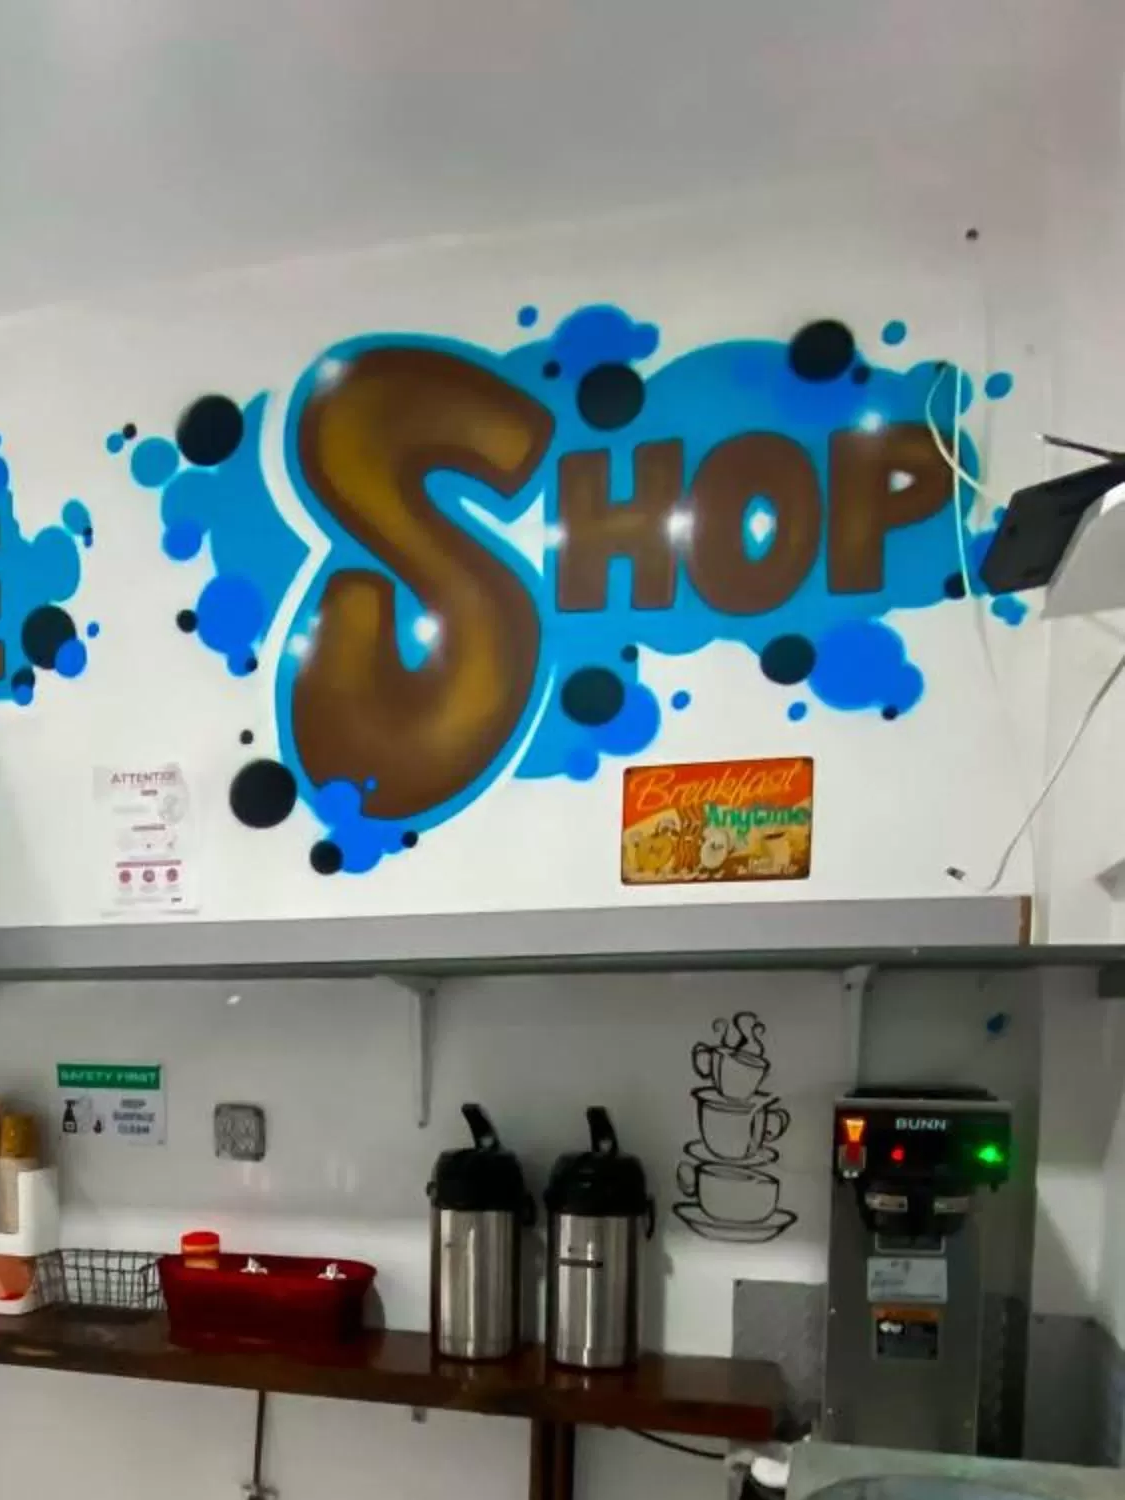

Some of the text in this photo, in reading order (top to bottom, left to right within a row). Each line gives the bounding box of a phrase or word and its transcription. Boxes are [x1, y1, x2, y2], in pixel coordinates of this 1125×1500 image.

[290, 345, 957, 819] SHOP
[630, 759, 804, 812] Breakfast
[707, 804, 811, 835] Anytime
[60, 1070, 156, 1085] SAFETY FIRST
[895, 1118, 947, 1130] BUNN
